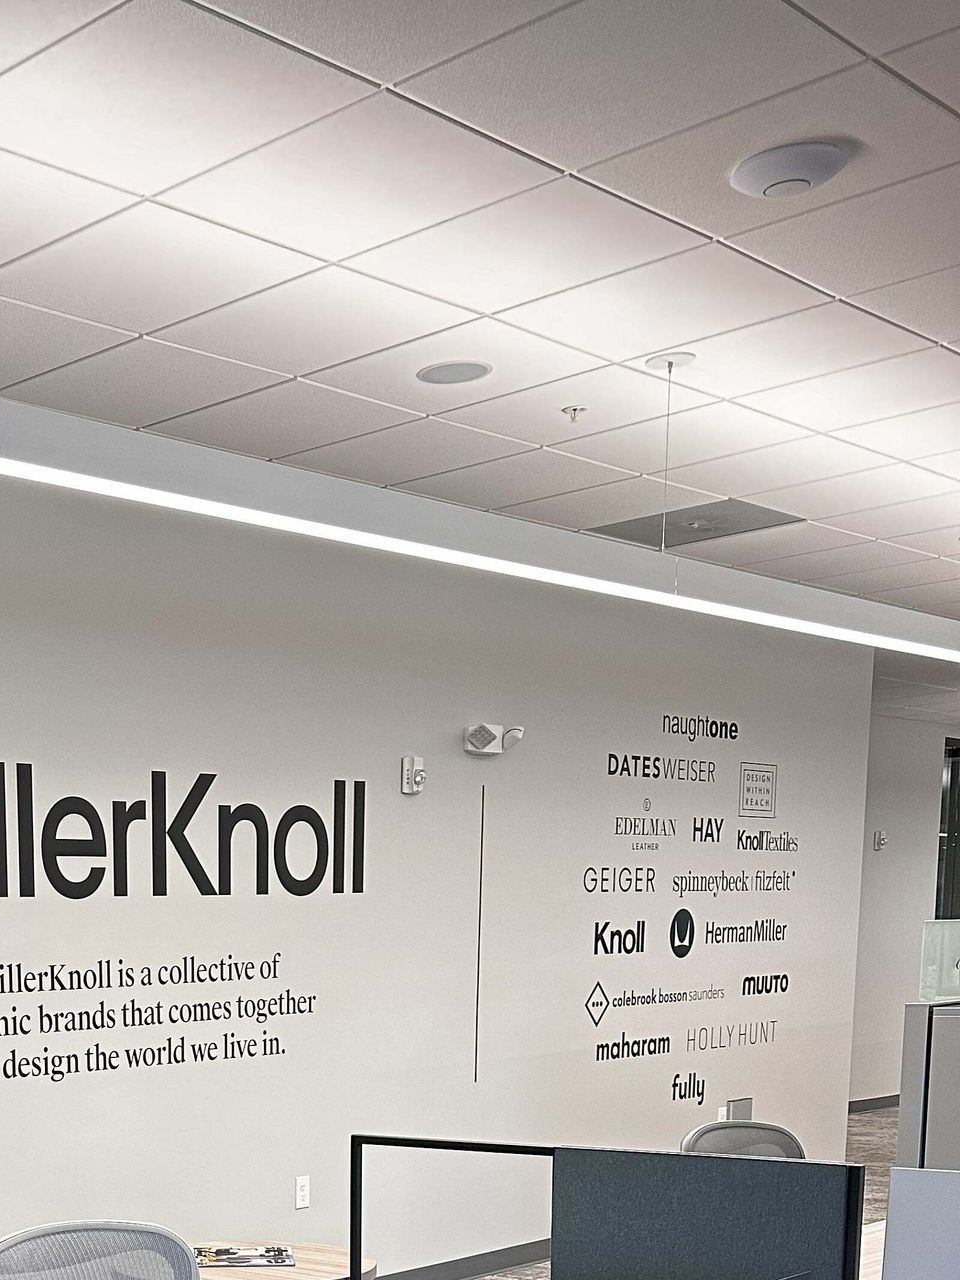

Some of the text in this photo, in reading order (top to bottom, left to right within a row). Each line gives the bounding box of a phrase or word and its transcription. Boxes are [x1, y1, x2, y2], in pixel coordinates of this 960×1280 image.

[662, 713, 739, 743] naughtone
[607, 752, 716, 783] DATESWEISER
[746, 773, 772, 783] DESIGN
[745, 798, 770, 808] REACH
[746, 786, 771, 796] WITHIN
[614, 817, 677, 837] EDELMAN
[692, 817, 724, 843] HAY
[737, 829, 798, 852] KnollTextiles
[632, 842, 659, 851] LEATHER
[583, 867, 656, 893] GEIGER
[672, 870, 749, 898] spinneybeck
[594, 920, 645, 955] Knoll
[117, 958, 135, 988] is
[140, 965, 153, 986] a
[157, 954, 255, 985] collective
[259, 952, 282, 979] of
[612, 983, 725, 1008] colebrook bosson saunders
[38, 1001, 116, 1034] brands
[120, 999, 164, 1027] that
[168, 1000, 232, 1024] comes
[236, 989, 317, 1023] together
[596, 1031, 671, 1062] maharam
[686, 1020, 778, 1052] HOLLY HUNT
[2, 1045, 81, 1083] design
[84, 1042, 121, 1072] the
[124, 1036, 186, 1069] world
[190, 1039, 218, 1062] we
[222, 1031, 258, 1059] live
[262, 1029, 286, 1056] in.
[672, 1072, 706, 1106] fully
